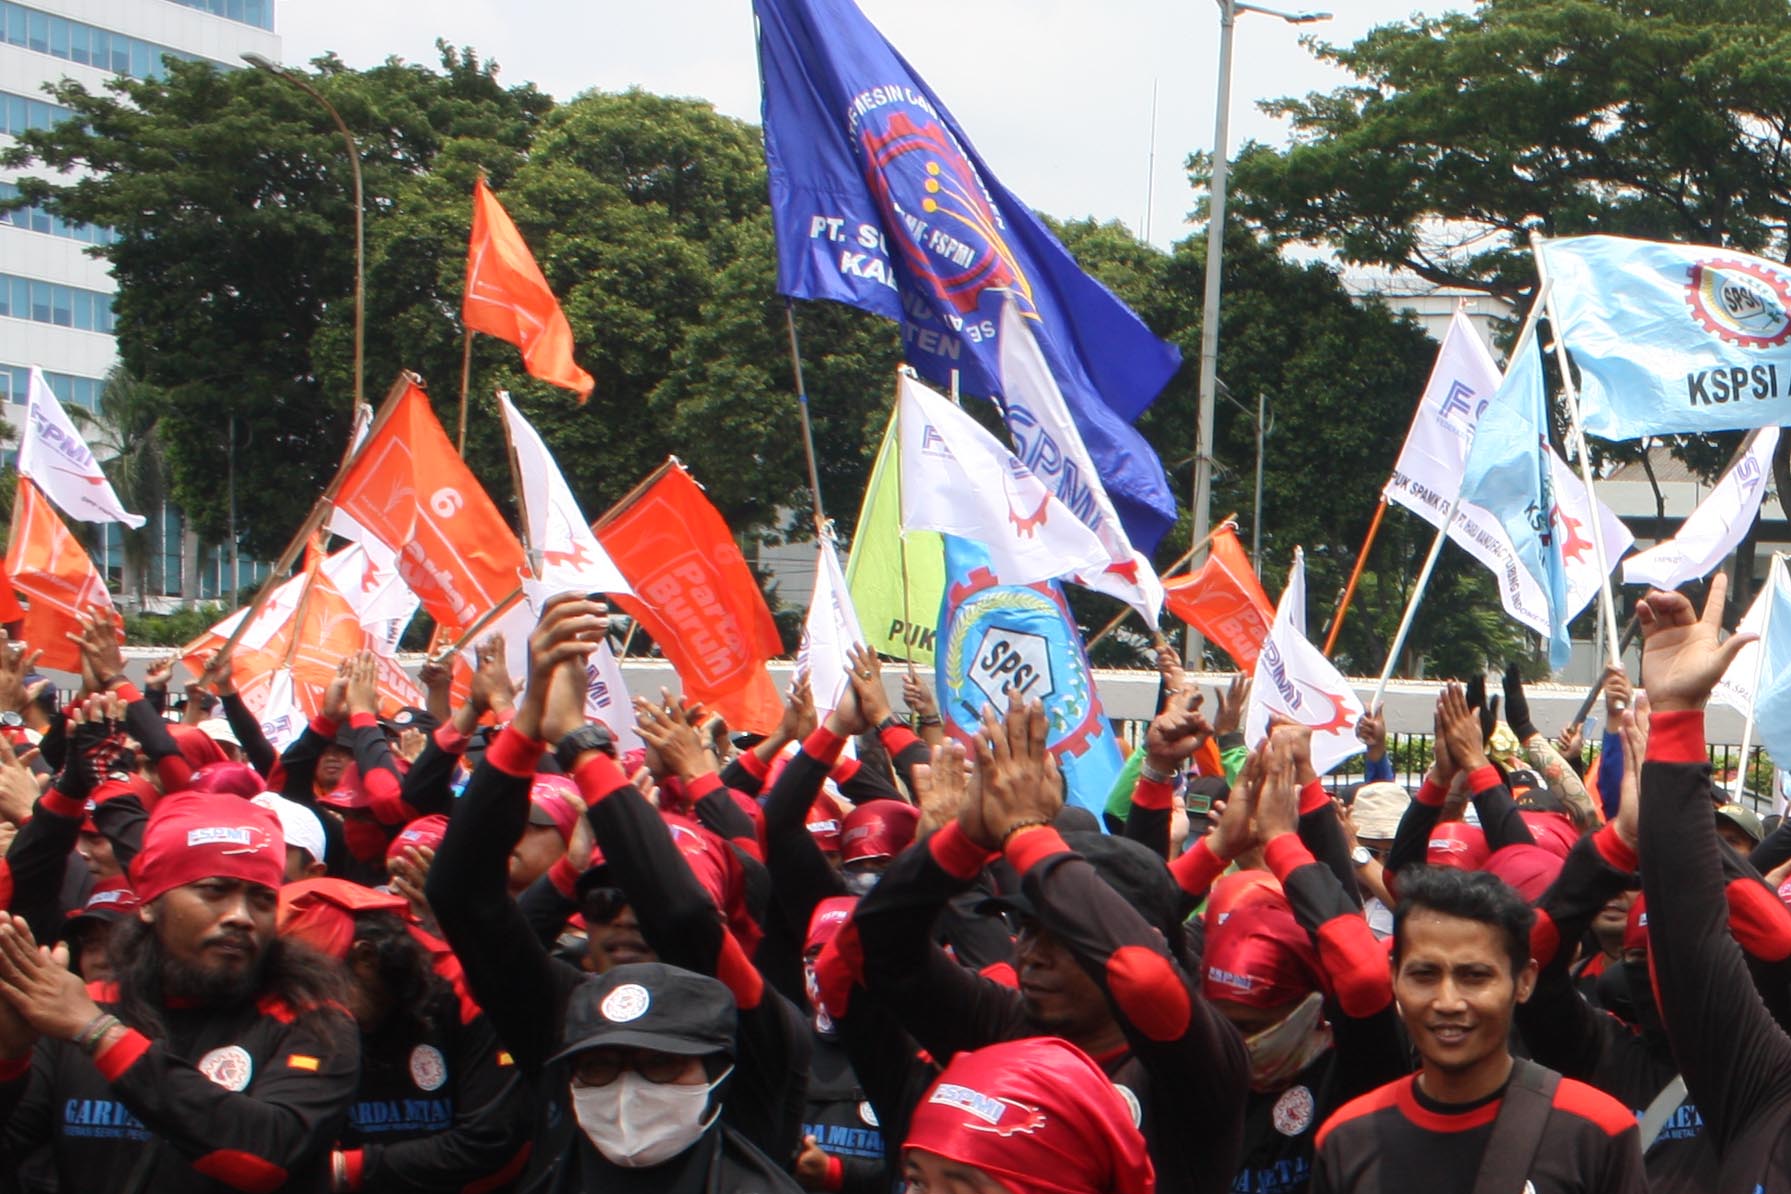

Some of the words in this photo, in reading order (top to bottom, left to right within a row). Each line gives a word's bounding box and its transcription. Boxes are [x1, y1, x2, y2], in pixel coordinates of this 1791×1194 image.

[809, 215, 845, 242] PT.
[928, 228, 976, 269] FSPMI
[1723, 286, 1762, 313] SPSI
[1686, 363, 1779, 407] KSPSI
[1007, 404, 1102, 533] SPMI
[430, 487, 464, 518] 6
[1410, 482, 1442, 504] SPAMK
[646, 574, 732, 676] Buruh
[888, 618, 937, 652] PUK
[188, 826, 251, 847] FSPMI
[929, 1082, 1007, 1126] FSPMI
